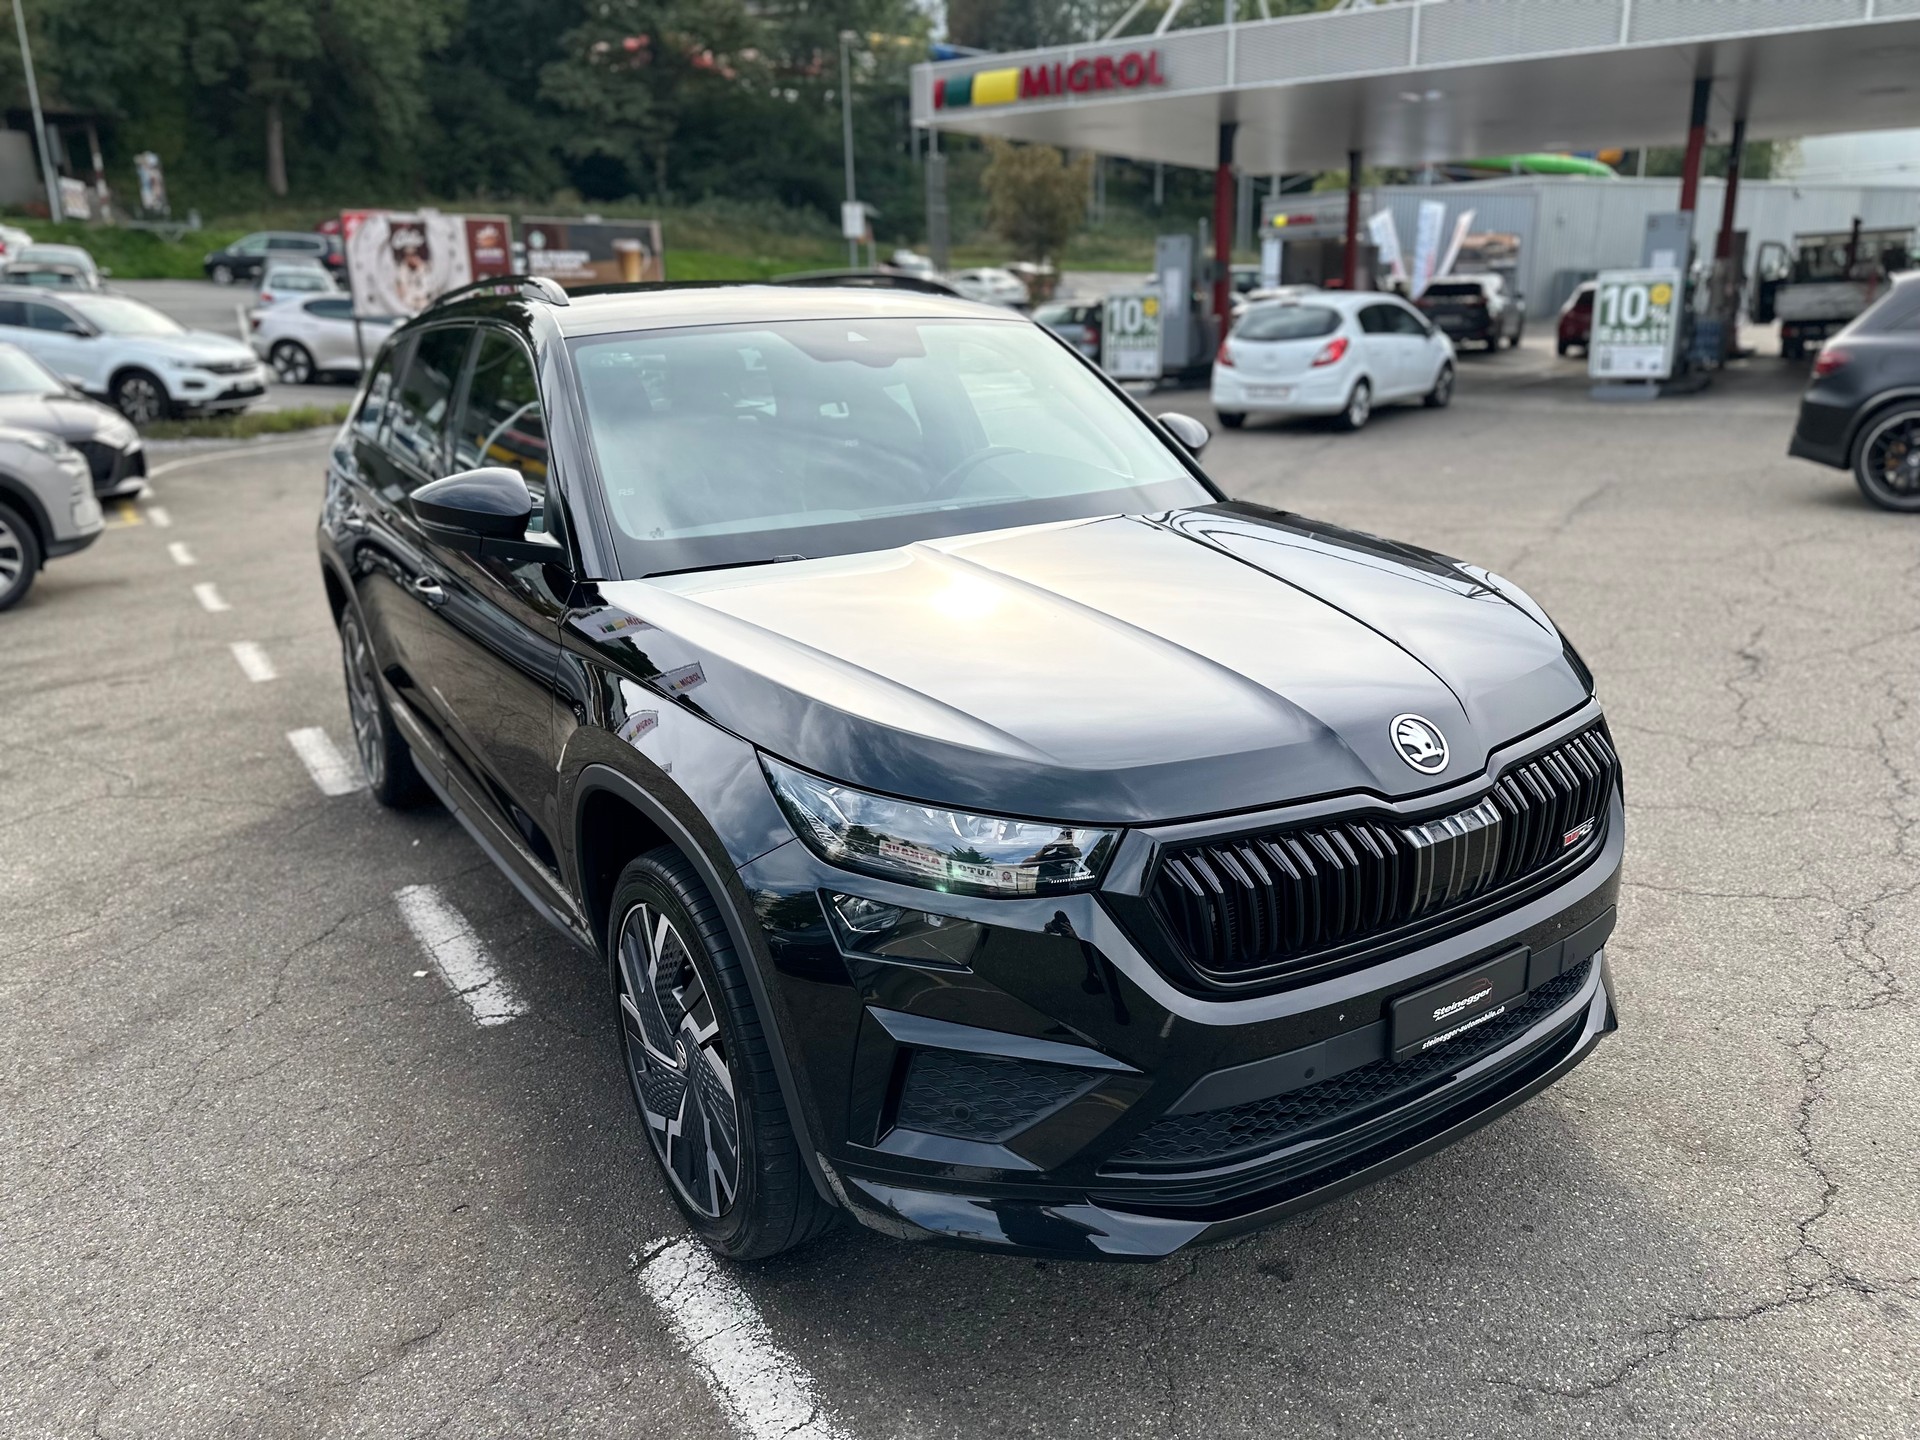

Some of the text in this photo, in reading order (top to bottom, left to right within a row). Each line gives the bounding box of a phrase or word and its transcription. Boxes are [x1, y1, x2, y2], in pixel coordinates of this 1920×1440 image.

[1019, 50, 1165, 98] MIGROL
[1432, 987, 1492, 1019] Steinegger
[1421, 1005, 1505, 1049] steinegger-automobile.ch
